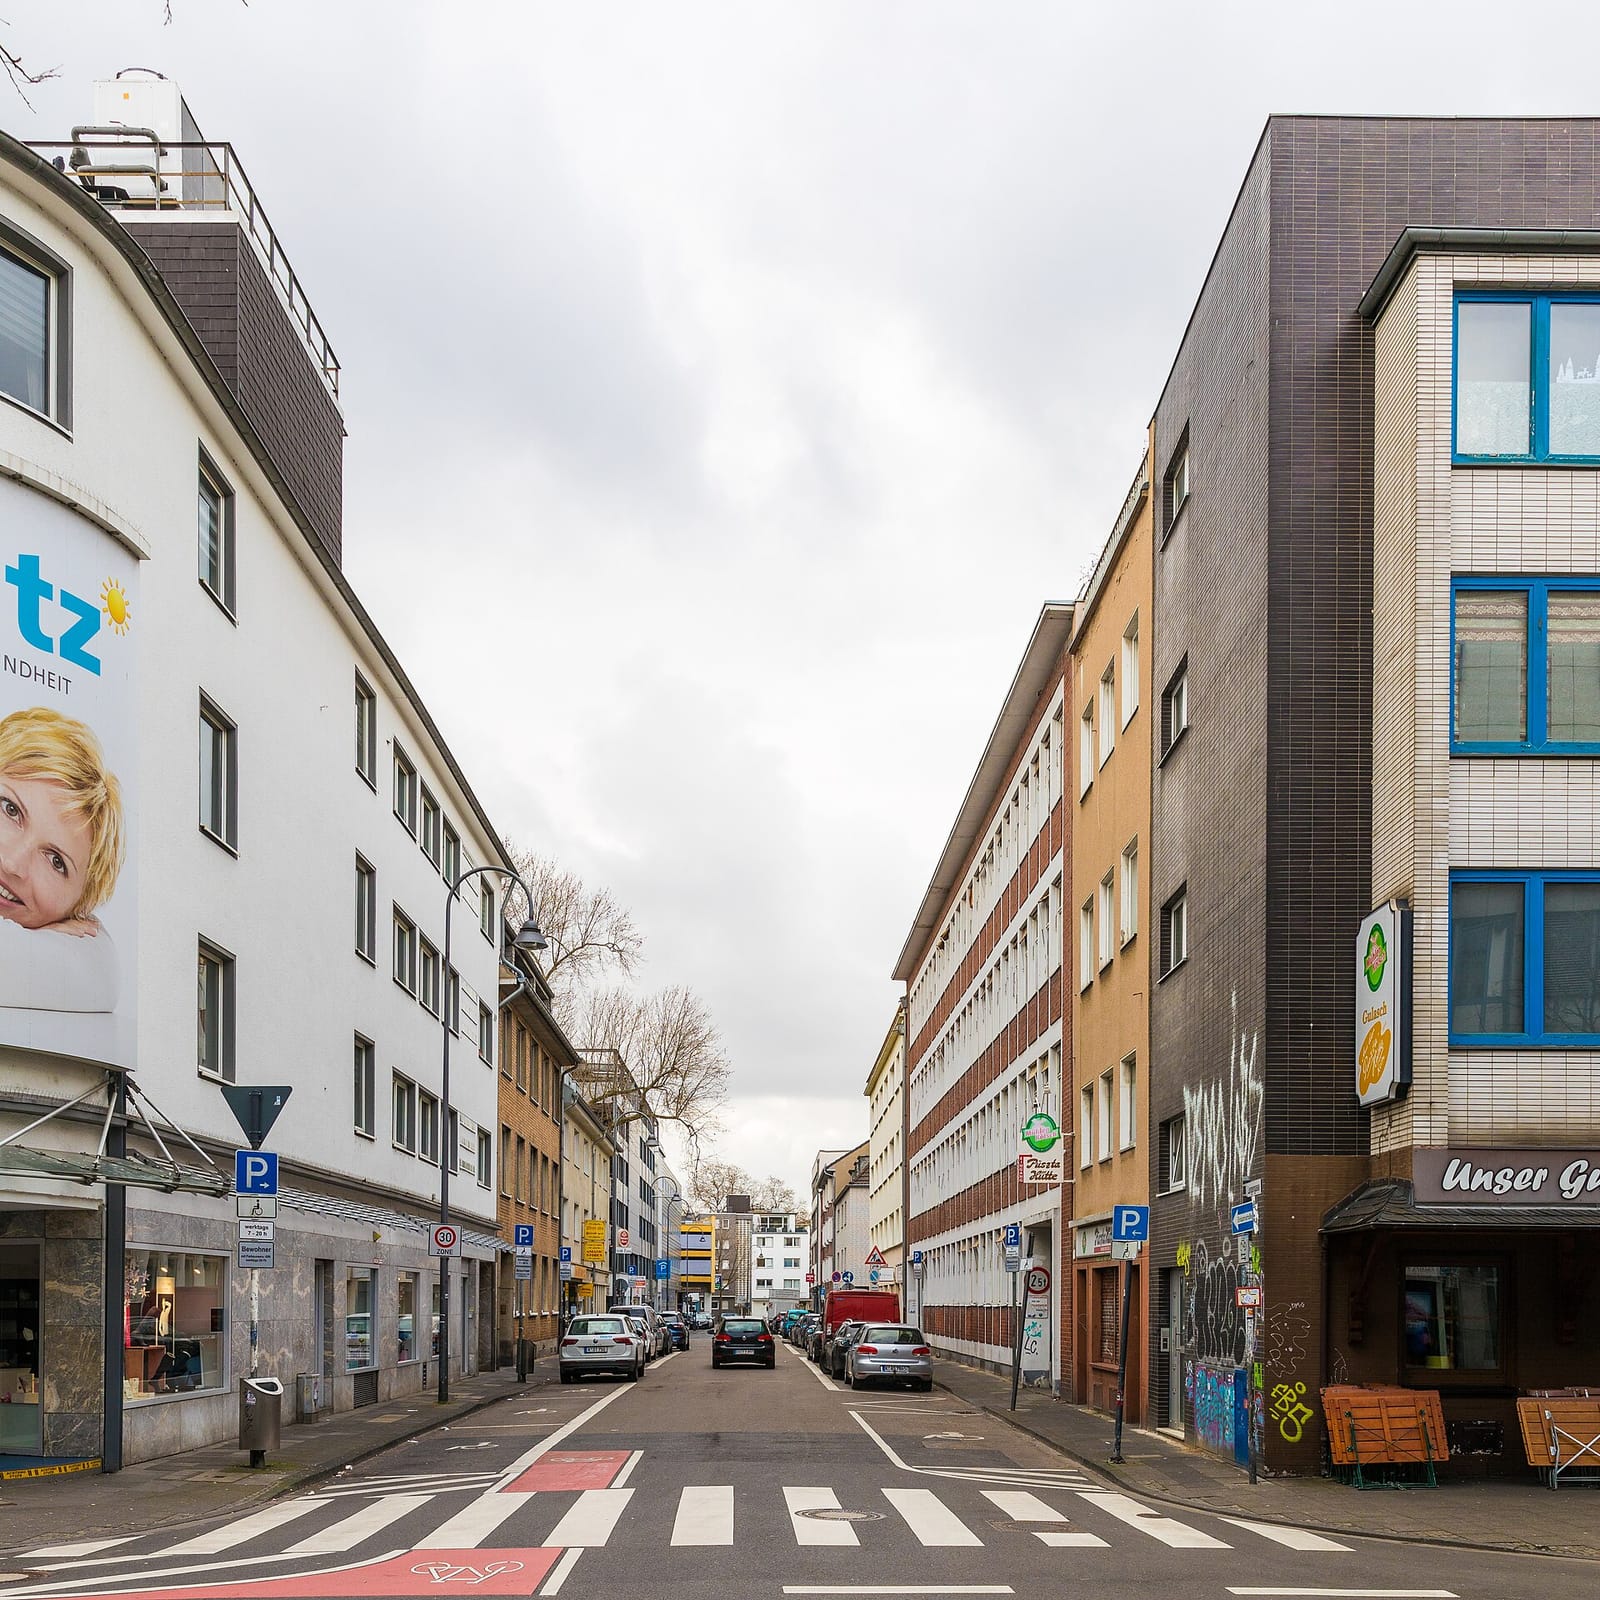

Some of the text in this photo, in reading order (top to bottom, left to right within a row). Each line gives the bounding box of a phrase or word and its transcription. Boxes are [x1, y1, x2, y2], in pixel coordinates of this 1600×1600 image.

[4, 654, 72, 695] NDHEIT
[1362, 1001, 1388, 1025] Gulasch
[246, 1156, 268, 1188] P
[1441, 1157, 1549, 1196] Unser
[244, 1224, 269, 1232] werktags
[1121, 1210, 1140, 1236] P
[438, 1232, 452, 1243] 30
[519, 1227, 530, 1243] P
[1008, 1229, 1015, 1243] P
[241, 1245, 272, 1253] Bewohner
